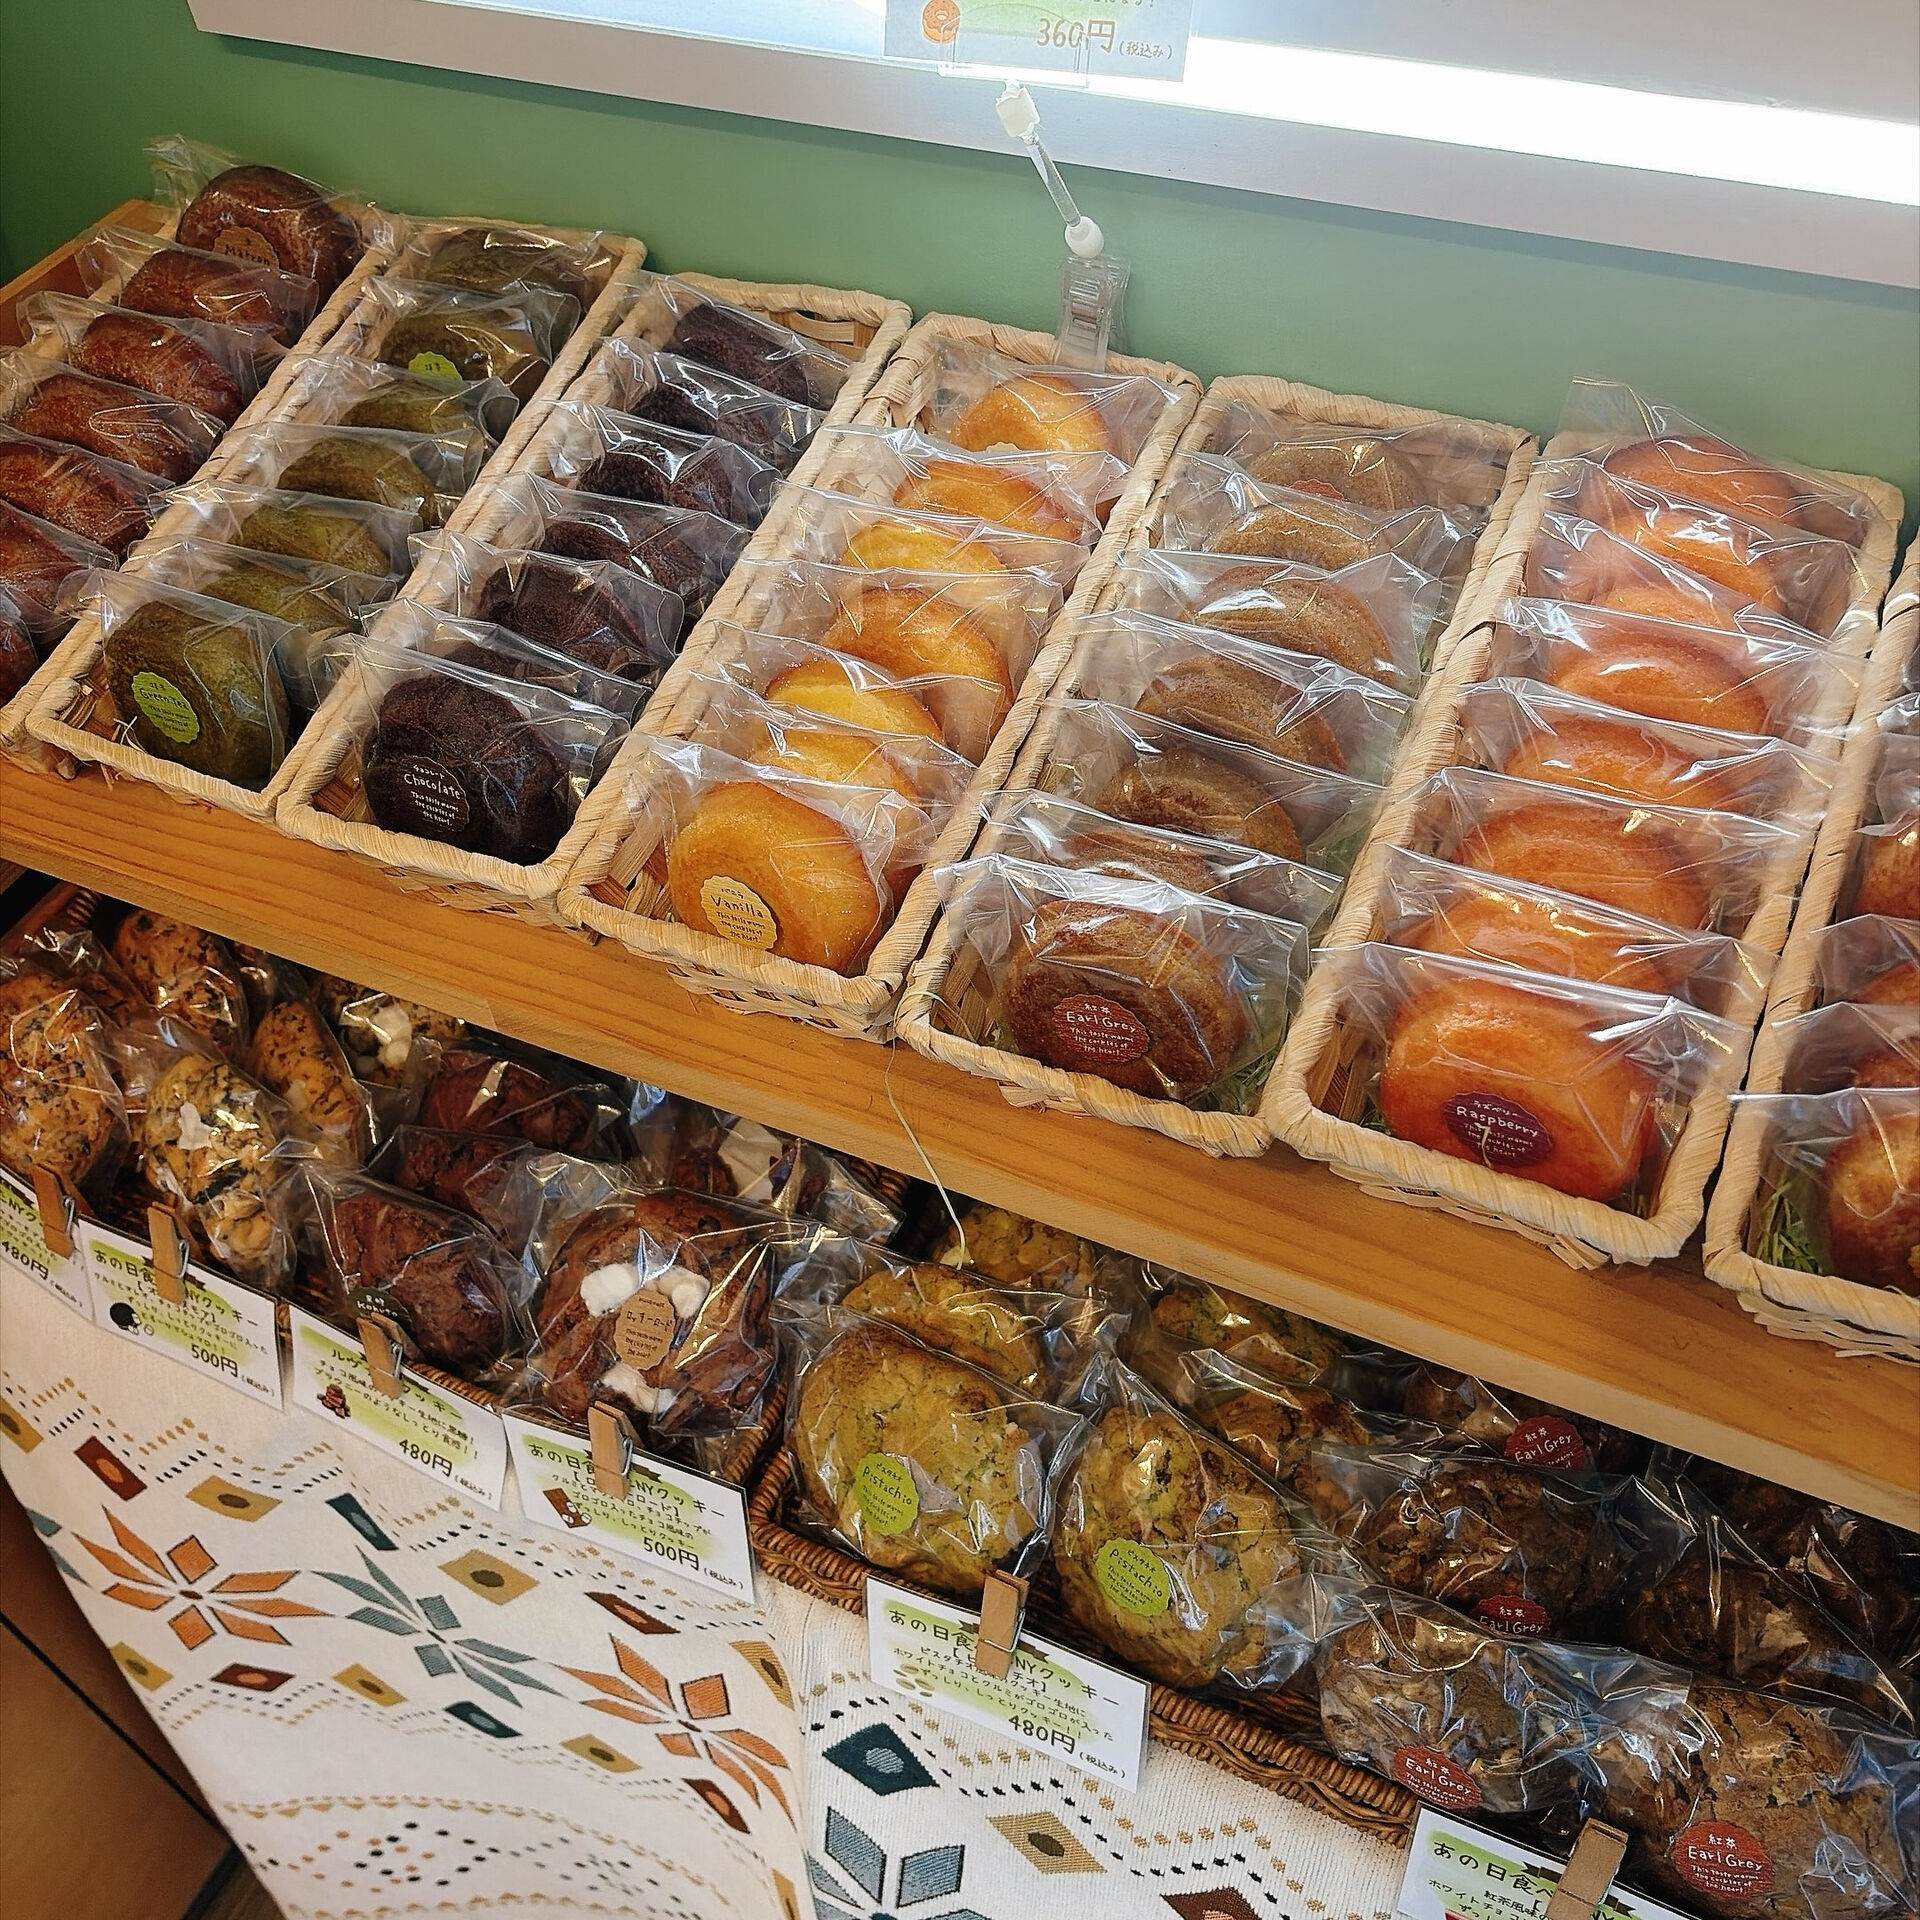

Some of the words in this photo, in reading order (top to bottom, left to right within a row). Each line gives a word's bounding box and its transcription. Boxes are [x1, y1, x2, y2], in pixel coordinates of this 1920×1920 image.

[1036, 18, 1115, 53] 360円
[403, 773, 461, 800] Chocolate
[710, 895, 764, 919] Vanilla
[1066, 1010, 1098, 1025] Earl
[1102, 1017, 1136, 1033] Grey
[1456, 1106, 1539, 1138] Raspberry
[2, 1240, 49, 1281] 480円
[191, 1343, 238, 1378] 500円
[399, 1438, 452, 1477] 480円
[1544, 1435, 1573, 1453] Grey
[862, 1466, 912, 1505] Pistachio
[643, 1537, 700, 1571] 500円
[1109, 1548, 1163, 1597] Pistachio
[1480, 1615, 1509, 1632] Earl
[1512, 1621, 1543, 1634] Grey
[1008, 1715, 1075, 1754] 480円
[1405, 1757, 1435, 1779] Earl
[1438, 1775, 1471, 1795] Grey
[1688, 1845, 1722, 1863] Earl
[1725, 1853, 1762, 1871] Grey
[1708, 1833, 1738, 1850] 紅茶
